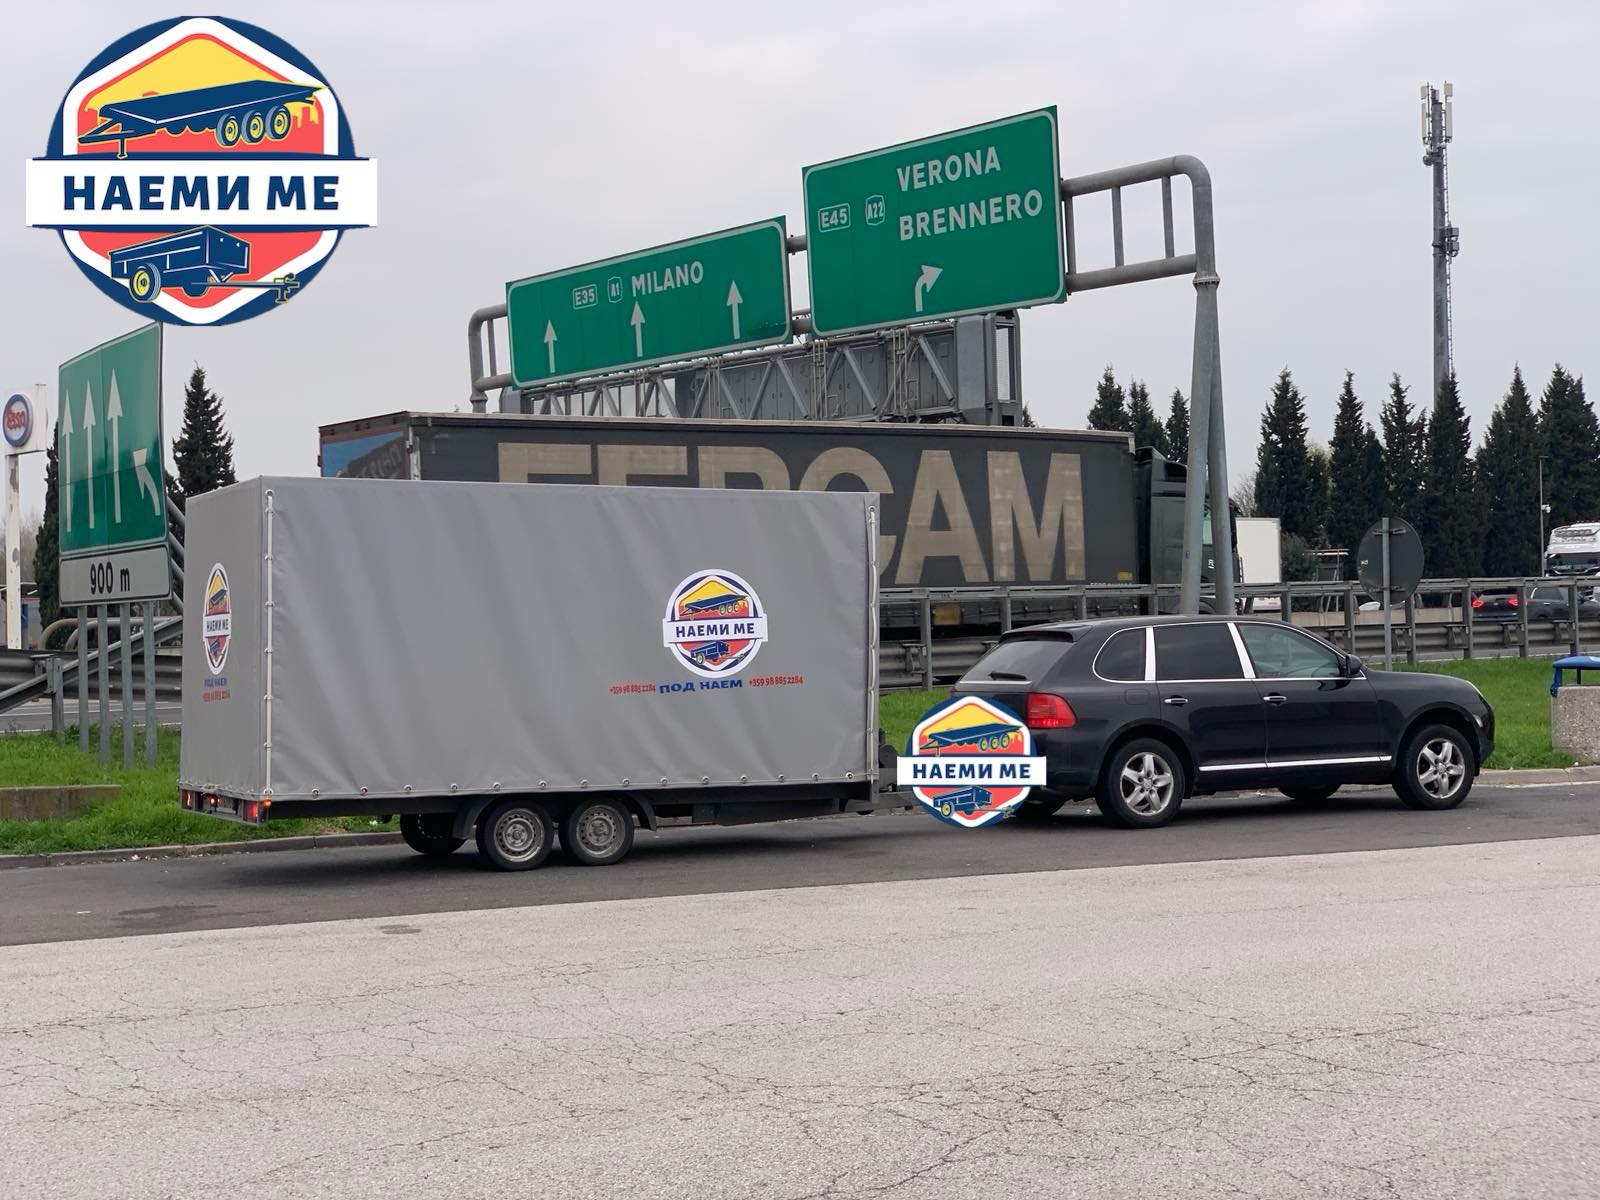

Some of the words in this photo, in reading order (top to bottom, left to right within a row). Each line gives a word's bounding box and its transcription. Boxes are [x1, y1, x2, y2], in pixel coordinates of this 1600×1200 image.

[896, 146, 1001, 192] VERONA
[820, 207, 848, 229] E45
[866, 199, 884, 219] A22
[899, 189, 1043, 241] BRENNERO
[609, 282, 621, 297] A1
[630, 260, 704, 298] MILANO
[574, 287, 596, 307] E35
[89, 561, 114, 595] 900
[119, 565, 131, 593] m
[675, 624, 730, 638] НАЕМИ
[733, 622, 755, 635] МЕ
[659, 682, 696, 694] ПОД
[699, 679, 743, 690] НАЕМ
